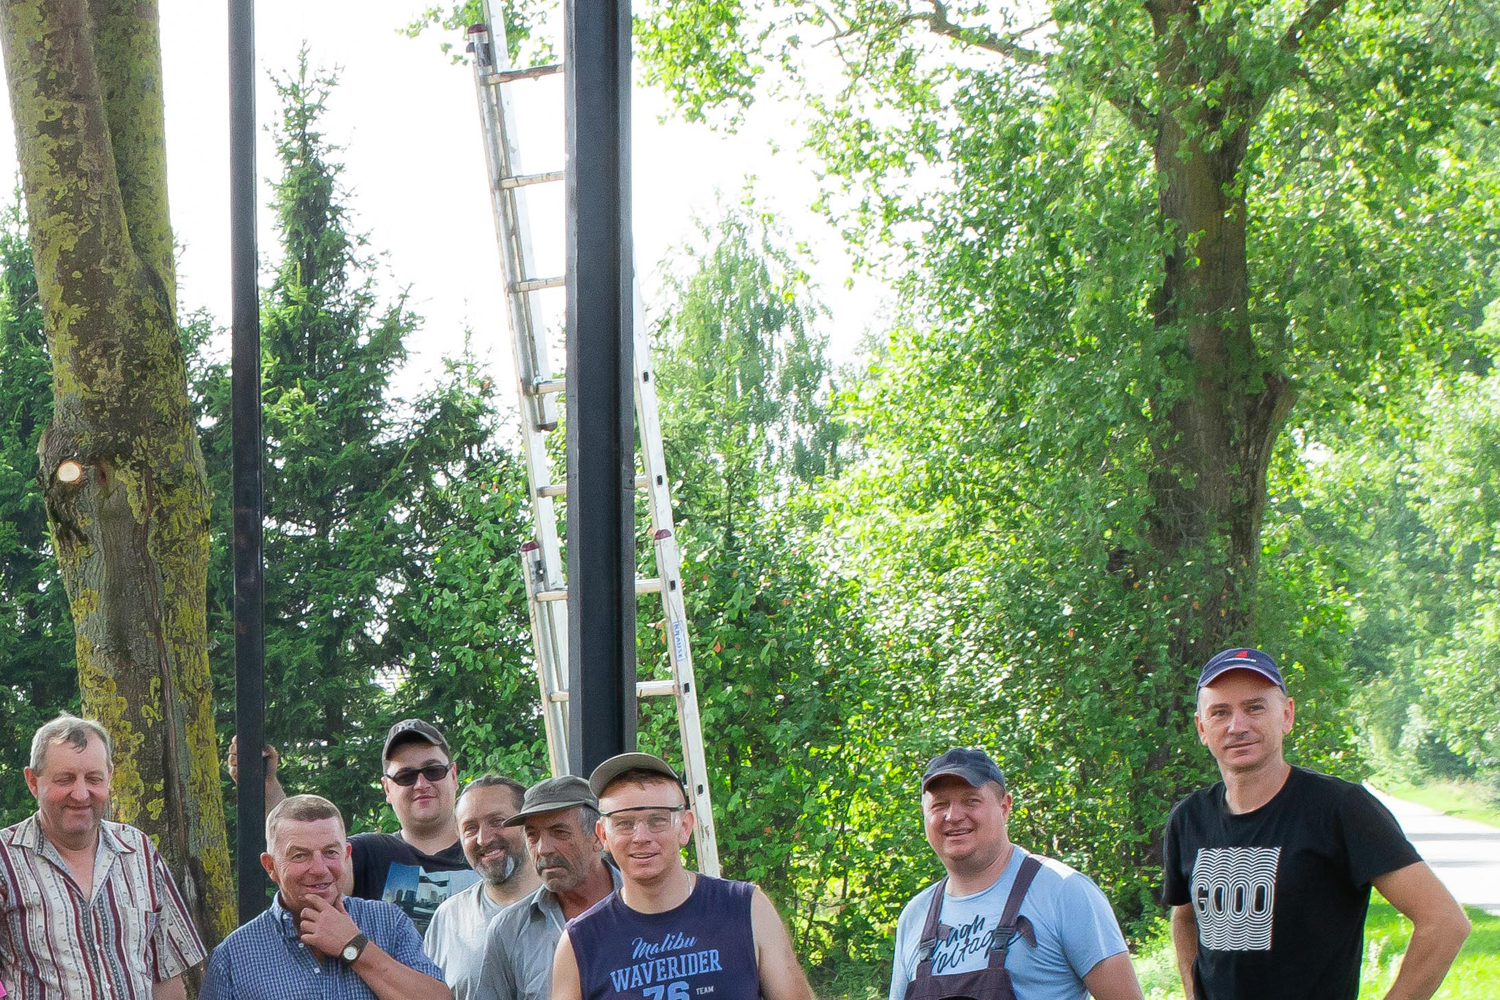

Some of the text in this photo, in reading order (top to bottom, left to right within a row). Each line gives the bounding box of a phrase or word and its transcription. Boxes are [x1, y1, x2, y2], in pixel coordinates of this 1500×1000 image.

[631, 931, 698, 960] Malibu
[610, 949, 723, 993] WAVERIDER
[695, 985, 714, 995] TEAM
